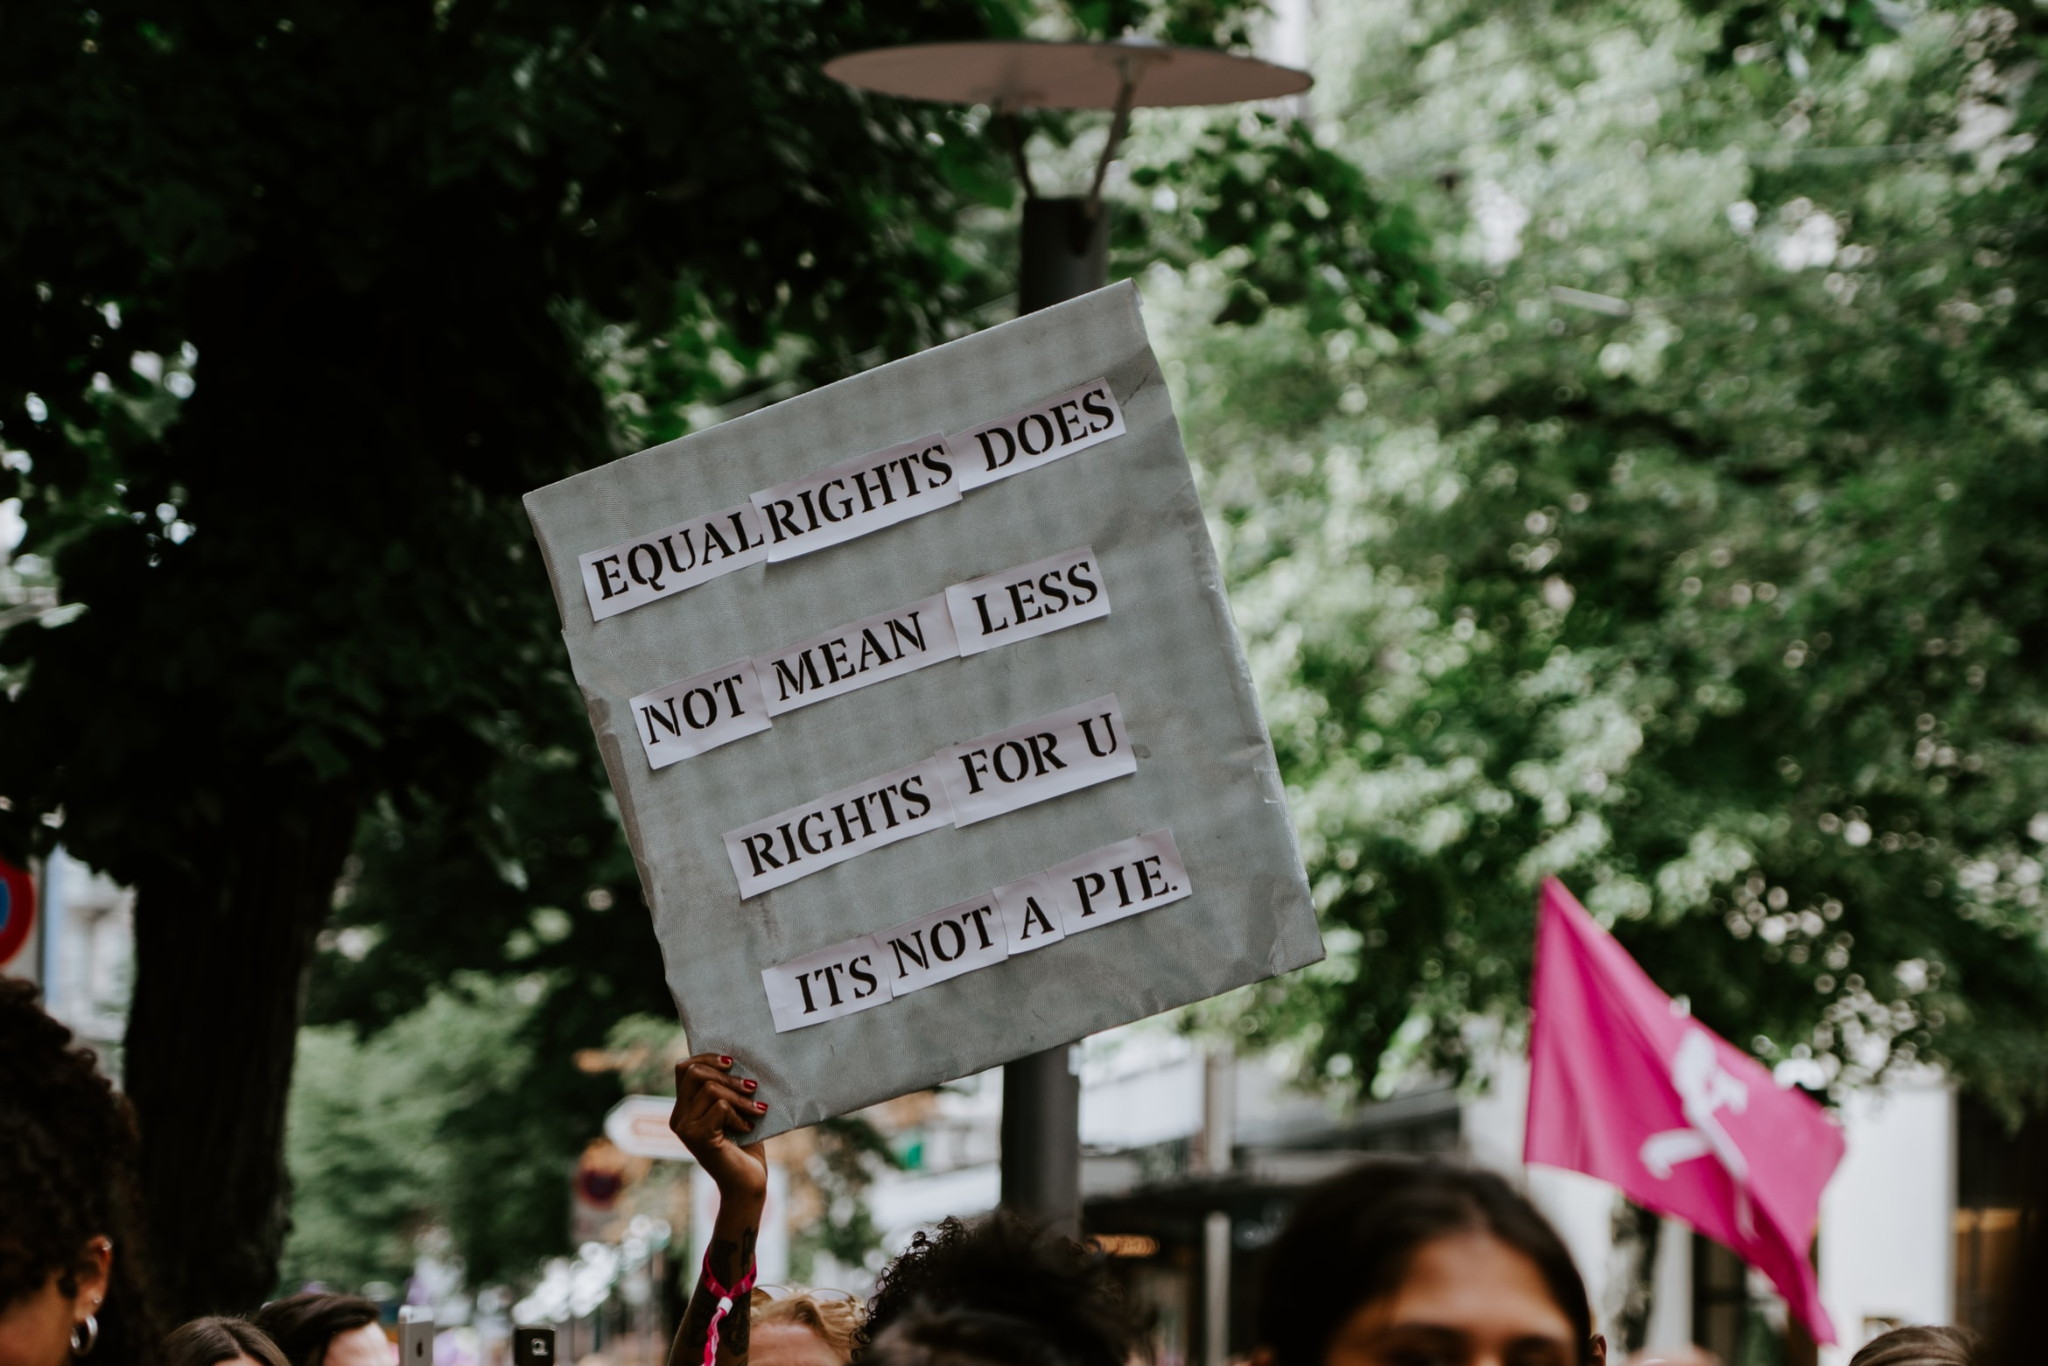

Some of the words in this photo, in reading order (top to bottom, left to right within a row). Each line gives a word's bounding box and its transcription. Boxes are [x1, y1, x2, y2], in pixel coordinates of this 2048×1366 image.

[592, 512, 764, 599] EQUAL
[762, 444, 952, 543] RIGHTS
[974, 389, 1114, 471] DOES
[641, 674, 745, 744] NOT
[771, 611, 926, 701] MEAN
[972, 562, 1097, 635] LESS
[741, 776, 930, 876] RIGHTS
[959, 732, 1067, 794] FOR
[1078, 713, 1117, 757] U
[796, 955, 877, 1013] ITS
[887, 905, 993, 978] NOT
[1021, 897, 1054, 939] A
[1072, 855, 1177, 917] PIE.
